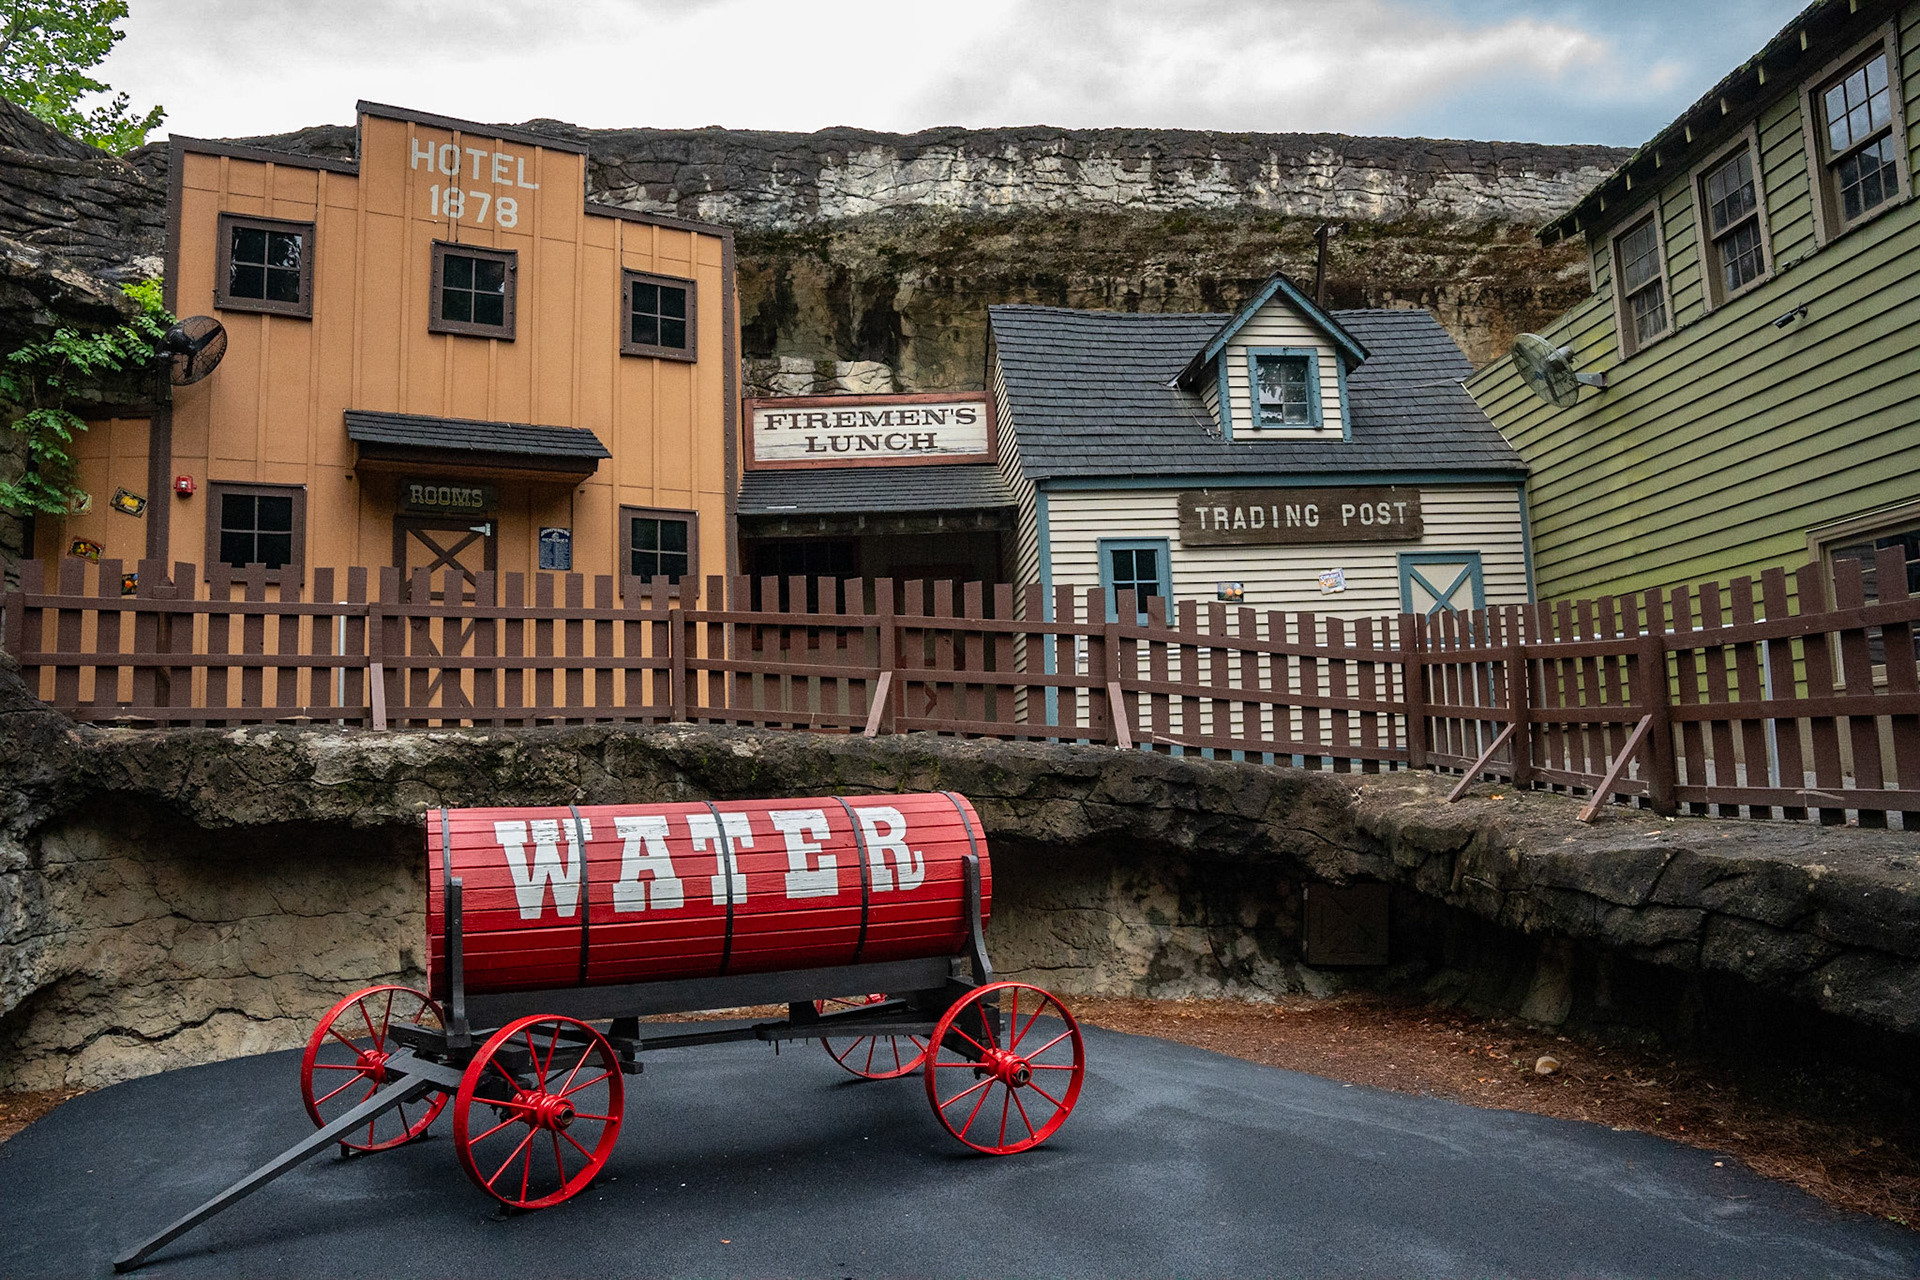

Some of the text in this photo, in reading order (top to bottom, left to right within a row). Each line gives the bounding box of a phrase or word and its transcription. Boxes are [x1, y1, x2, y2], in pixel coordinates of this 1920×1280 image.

[411, 137, 539, 190] HOTEL
[430, 184, 518, 228] 1878
[764, 407, 977, 430] FIREMEN'S
[805, 432, 938, 453] LUNCH
[409, 484, 483, 508] ROOMS
[1195, 502, 1406, 530] TRADING POST
[493, 805, 926, 920] WATER
